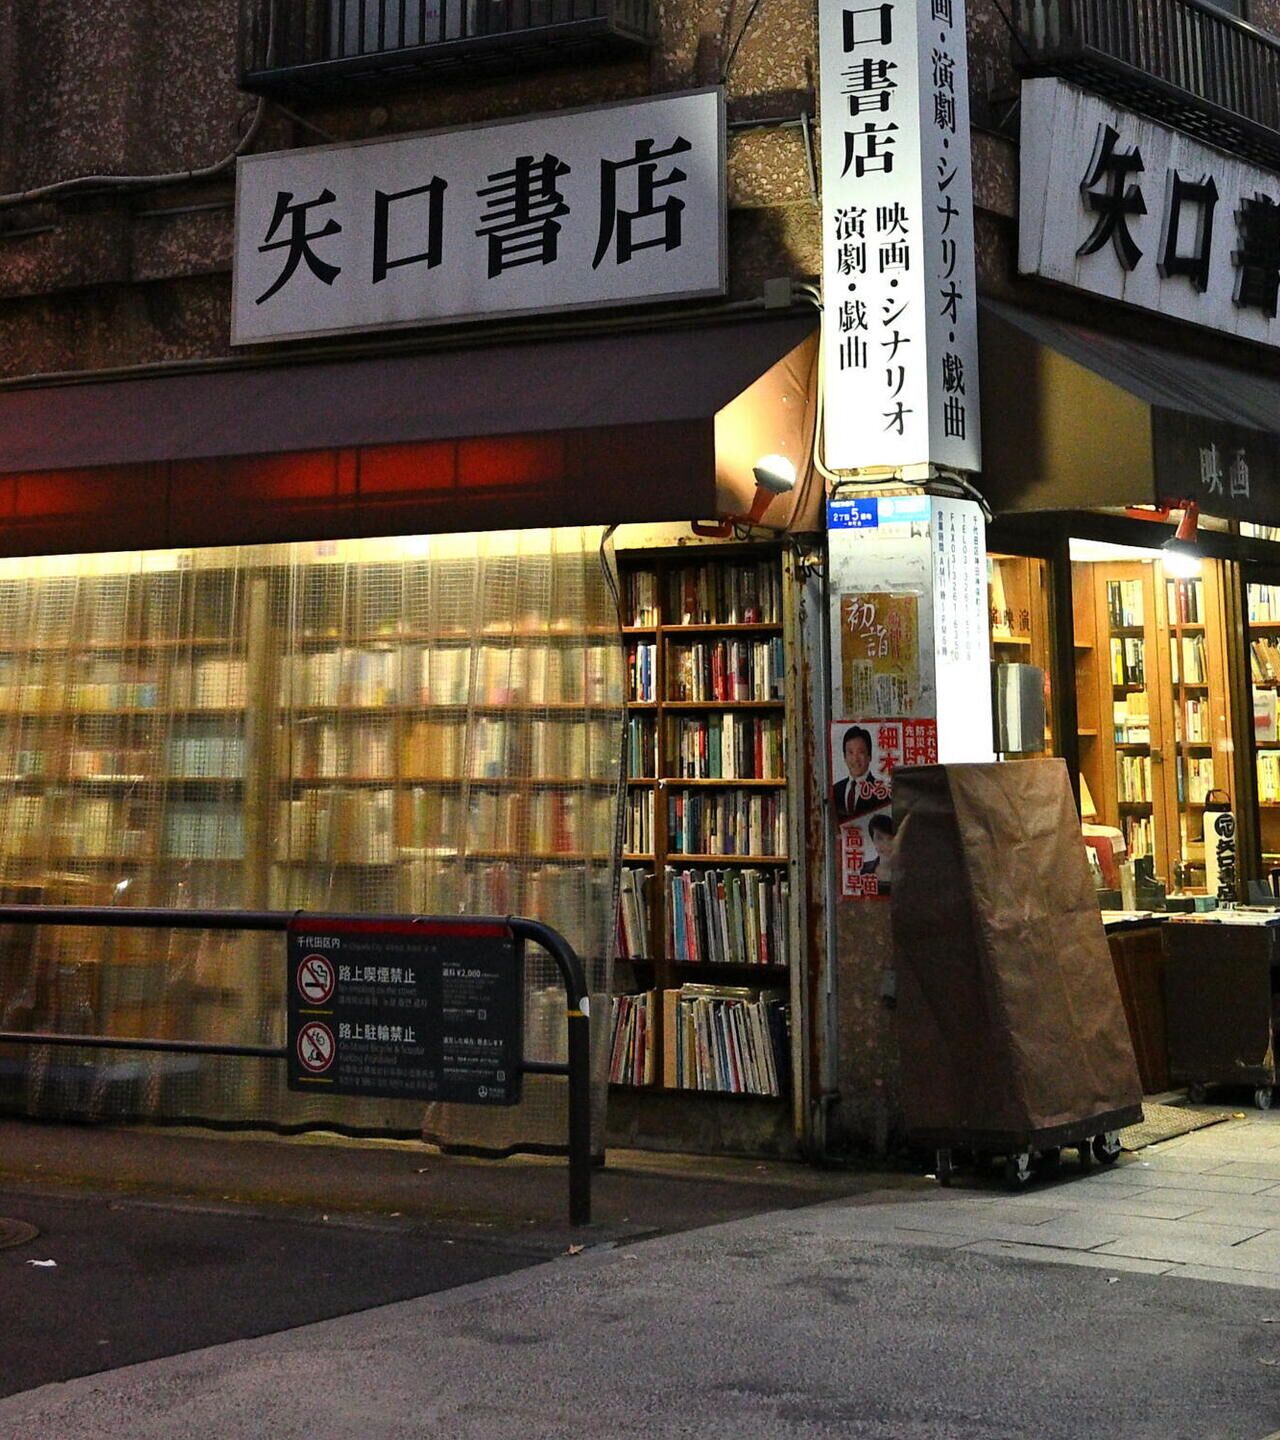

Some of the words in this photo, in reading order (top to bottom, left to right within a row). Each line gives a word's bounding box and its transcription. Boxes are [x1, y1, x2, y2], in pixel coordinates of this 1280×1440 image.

[255, 135, 693, 305] 矢口書店
[834, 205, 869, 372] 演劇・戯曲
[875, 201, 913, 436] 映画・シナリオ
[1199, 441, 1251, 501] 映画
[845, 596, 889, 658] 初詣
[858, 780, 892, 801] ひろ
[846, 825, 879, 895] 高市早苗
[297, 935, 341, 951] 千代田区内
[338, 965, 417, 985] 路上喫煙禁止
[338, 1022, 417, 1043] 路上駐輪禁止
